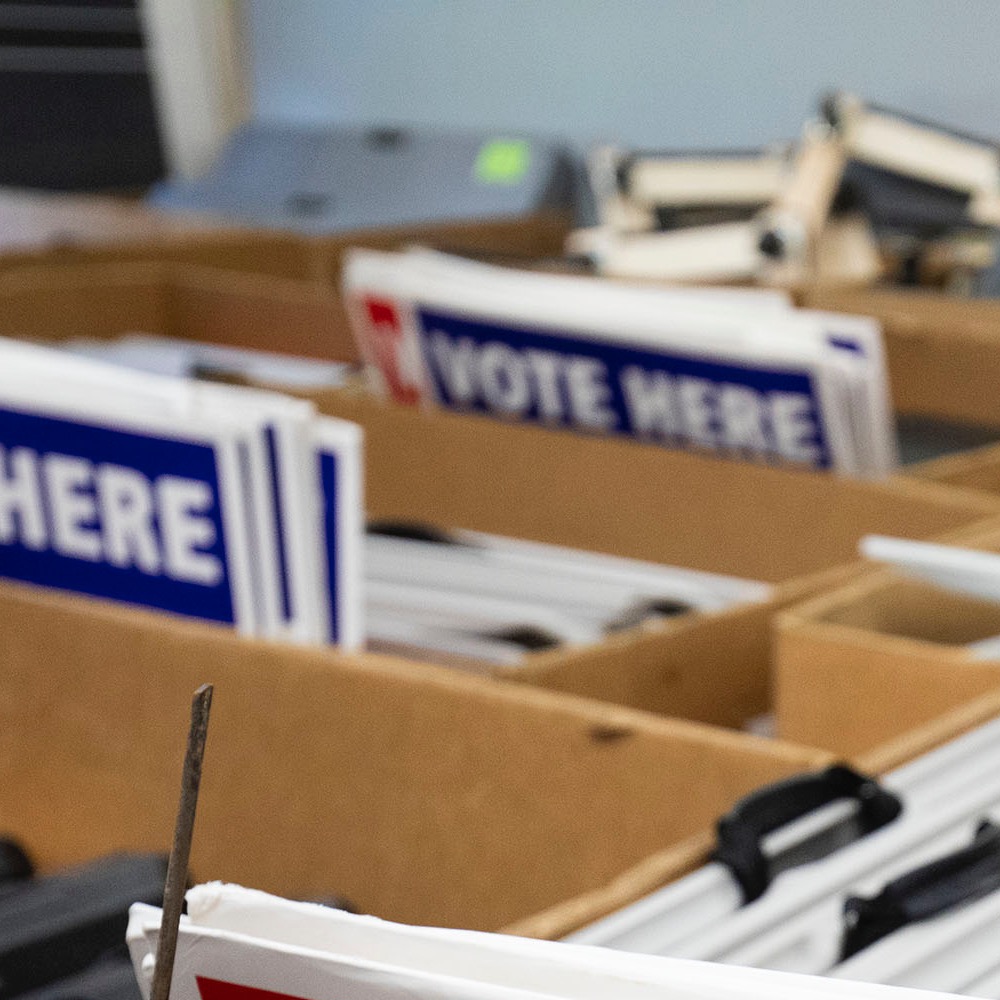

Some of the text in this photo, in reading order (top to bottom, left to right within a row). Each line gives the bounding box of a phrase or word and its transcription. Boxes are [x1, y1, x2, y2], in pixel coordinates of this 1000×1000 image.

[429, 330, 823, 466] VOTE HERE
[0, 443, 224, 588] HERE
